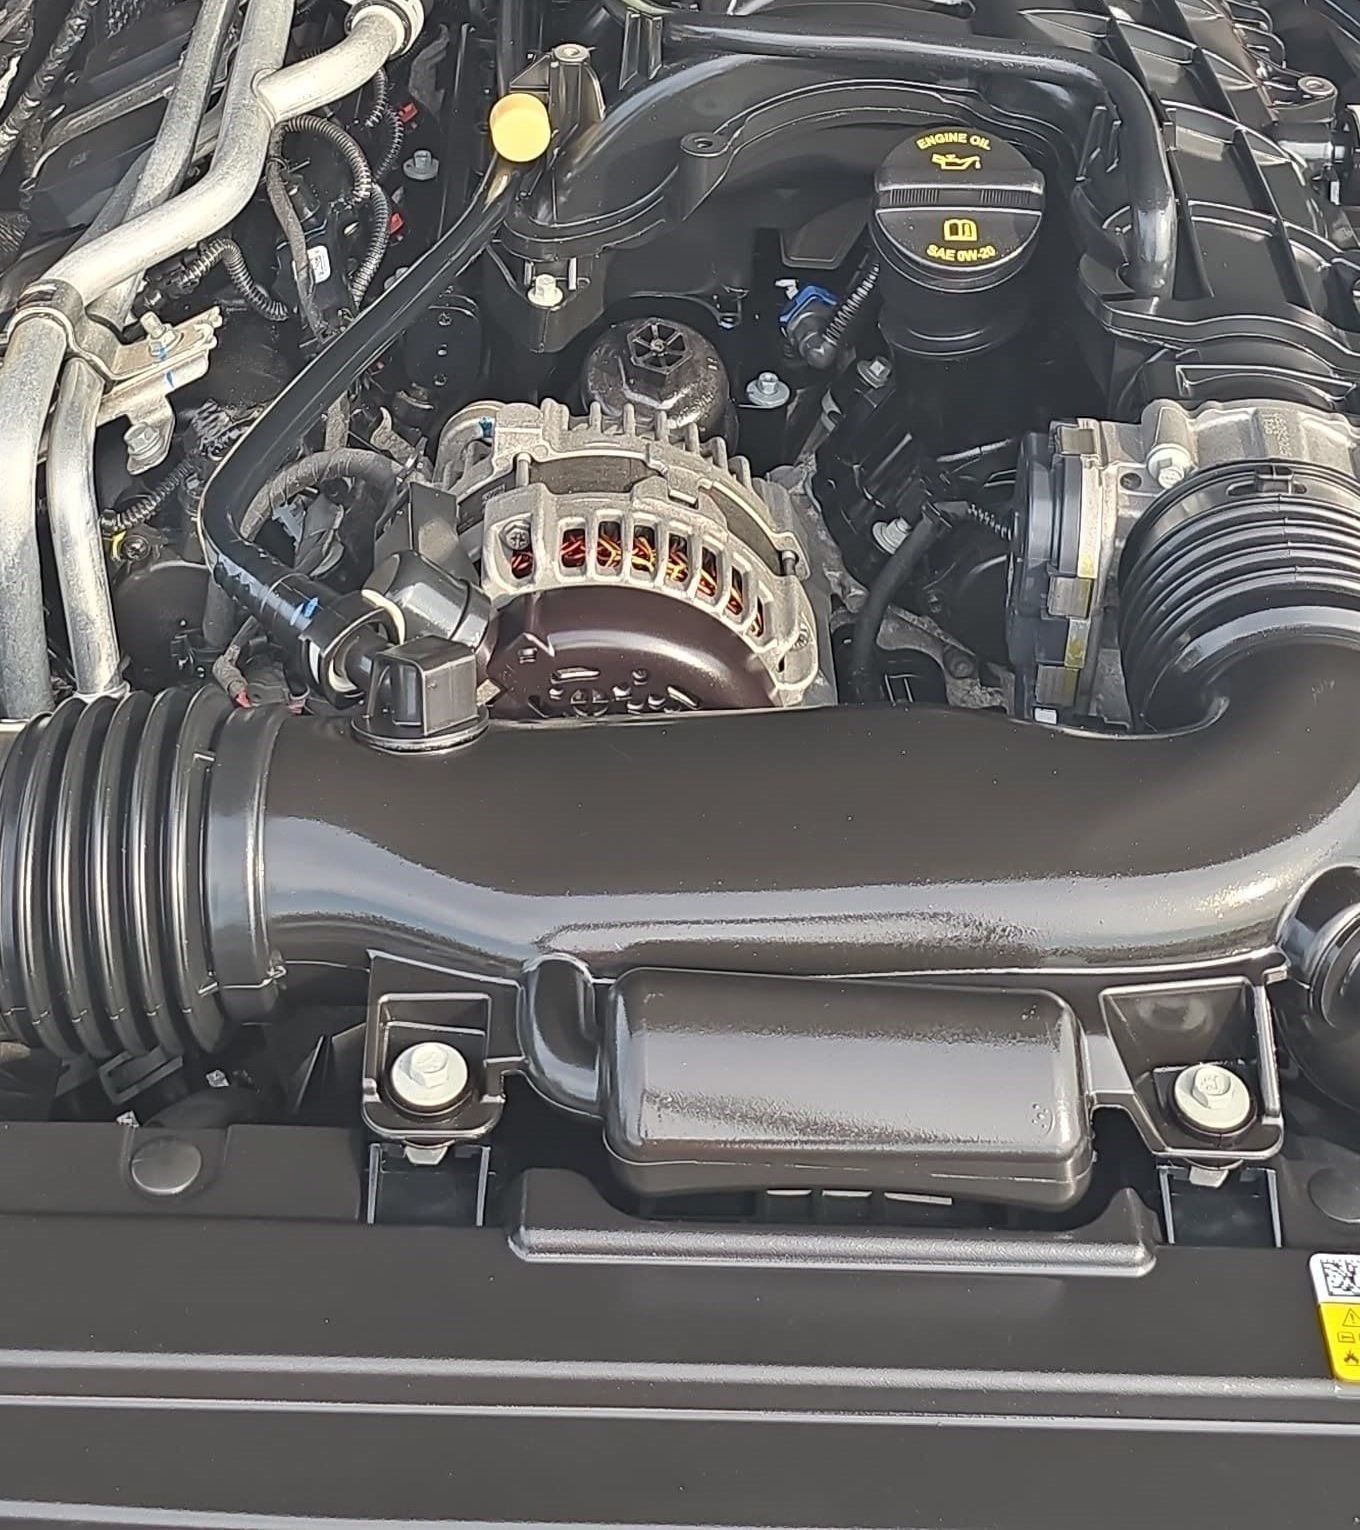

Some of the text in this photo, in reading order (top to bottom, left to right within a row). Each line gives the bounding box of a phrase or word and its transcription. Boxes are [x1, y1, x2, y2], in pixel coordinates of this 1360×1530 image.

[917, 133, 990, 150] ENGINE OIL
[927, 245, 995, 262] SAE 0W-20
